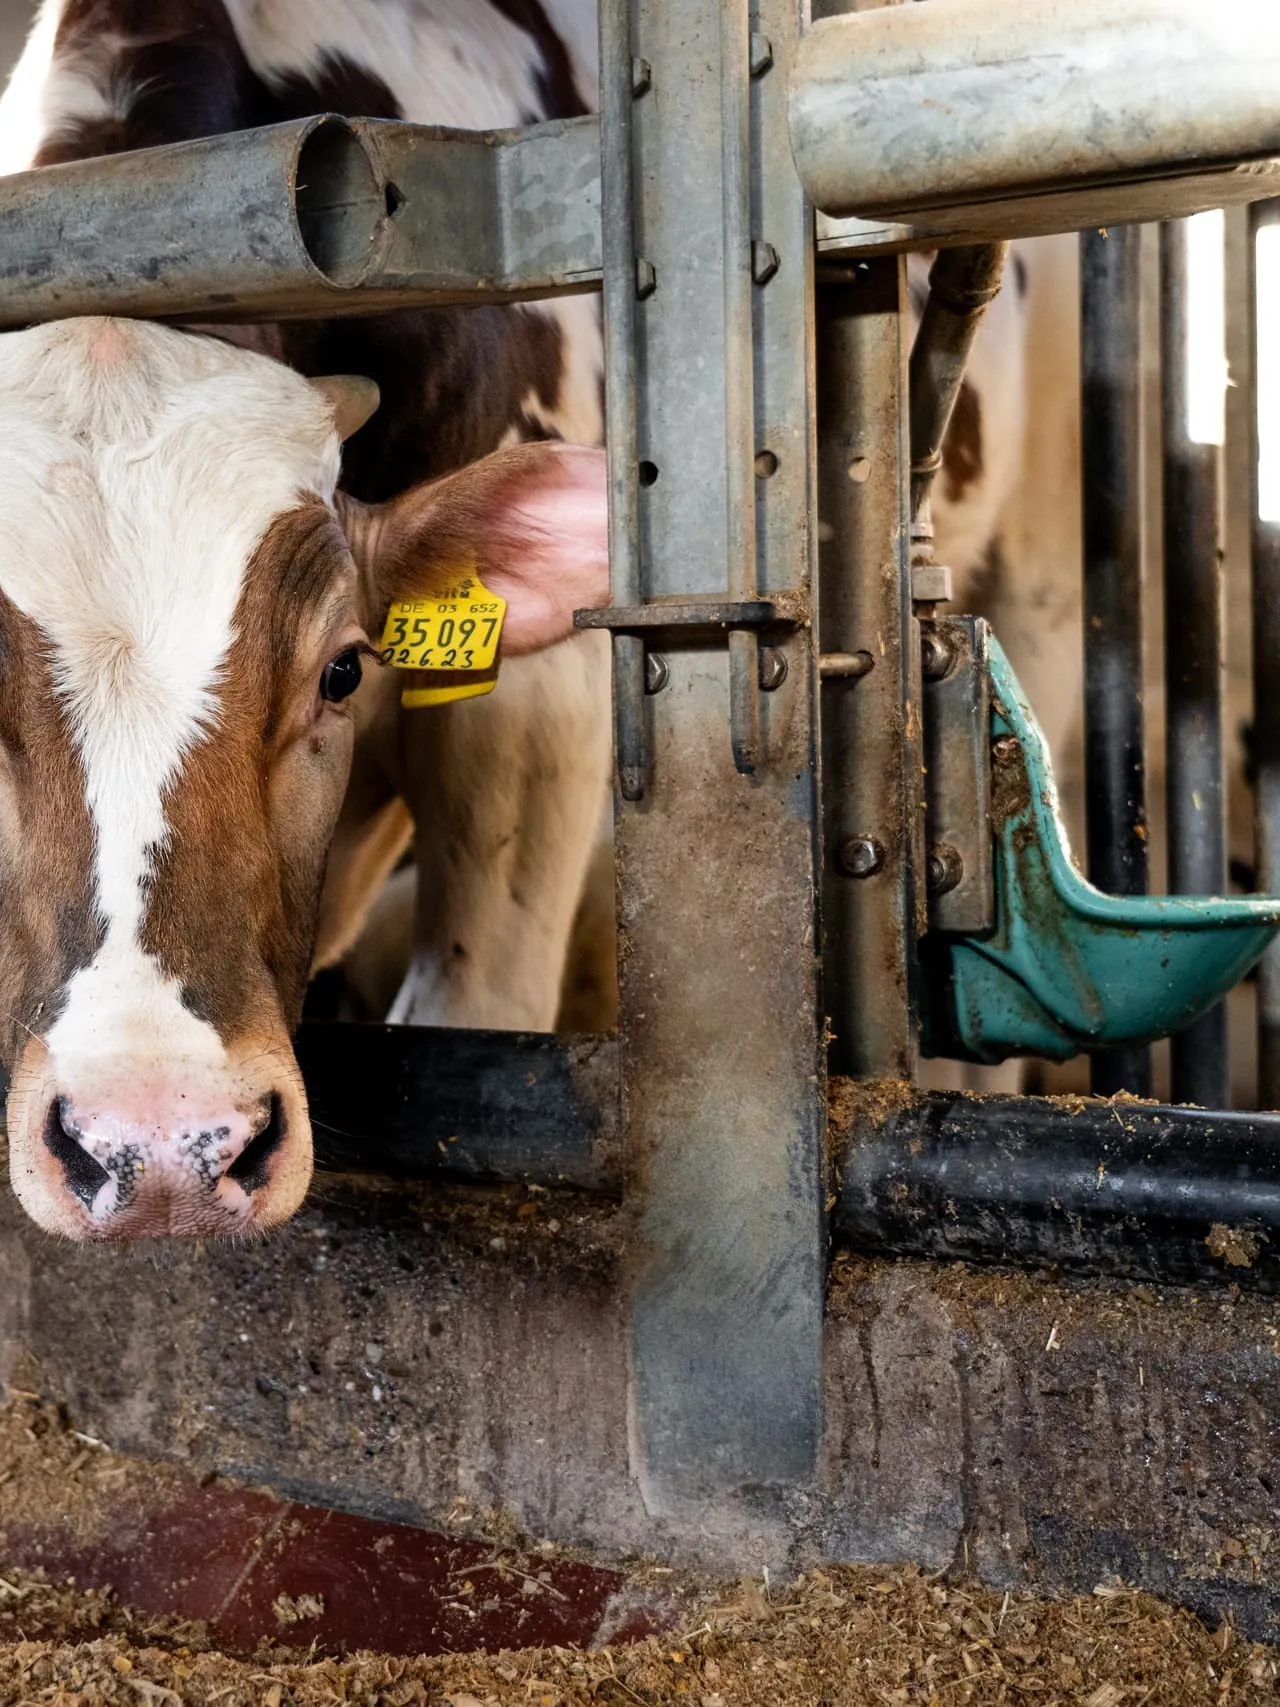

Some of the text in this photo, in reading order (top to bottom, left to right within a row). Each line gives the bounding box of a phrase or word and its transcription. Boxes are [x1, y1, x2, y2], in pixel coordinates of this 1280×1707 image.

[400, 602, 498, 614] DE 03 652
[388, 617, 498, 648] 35097
